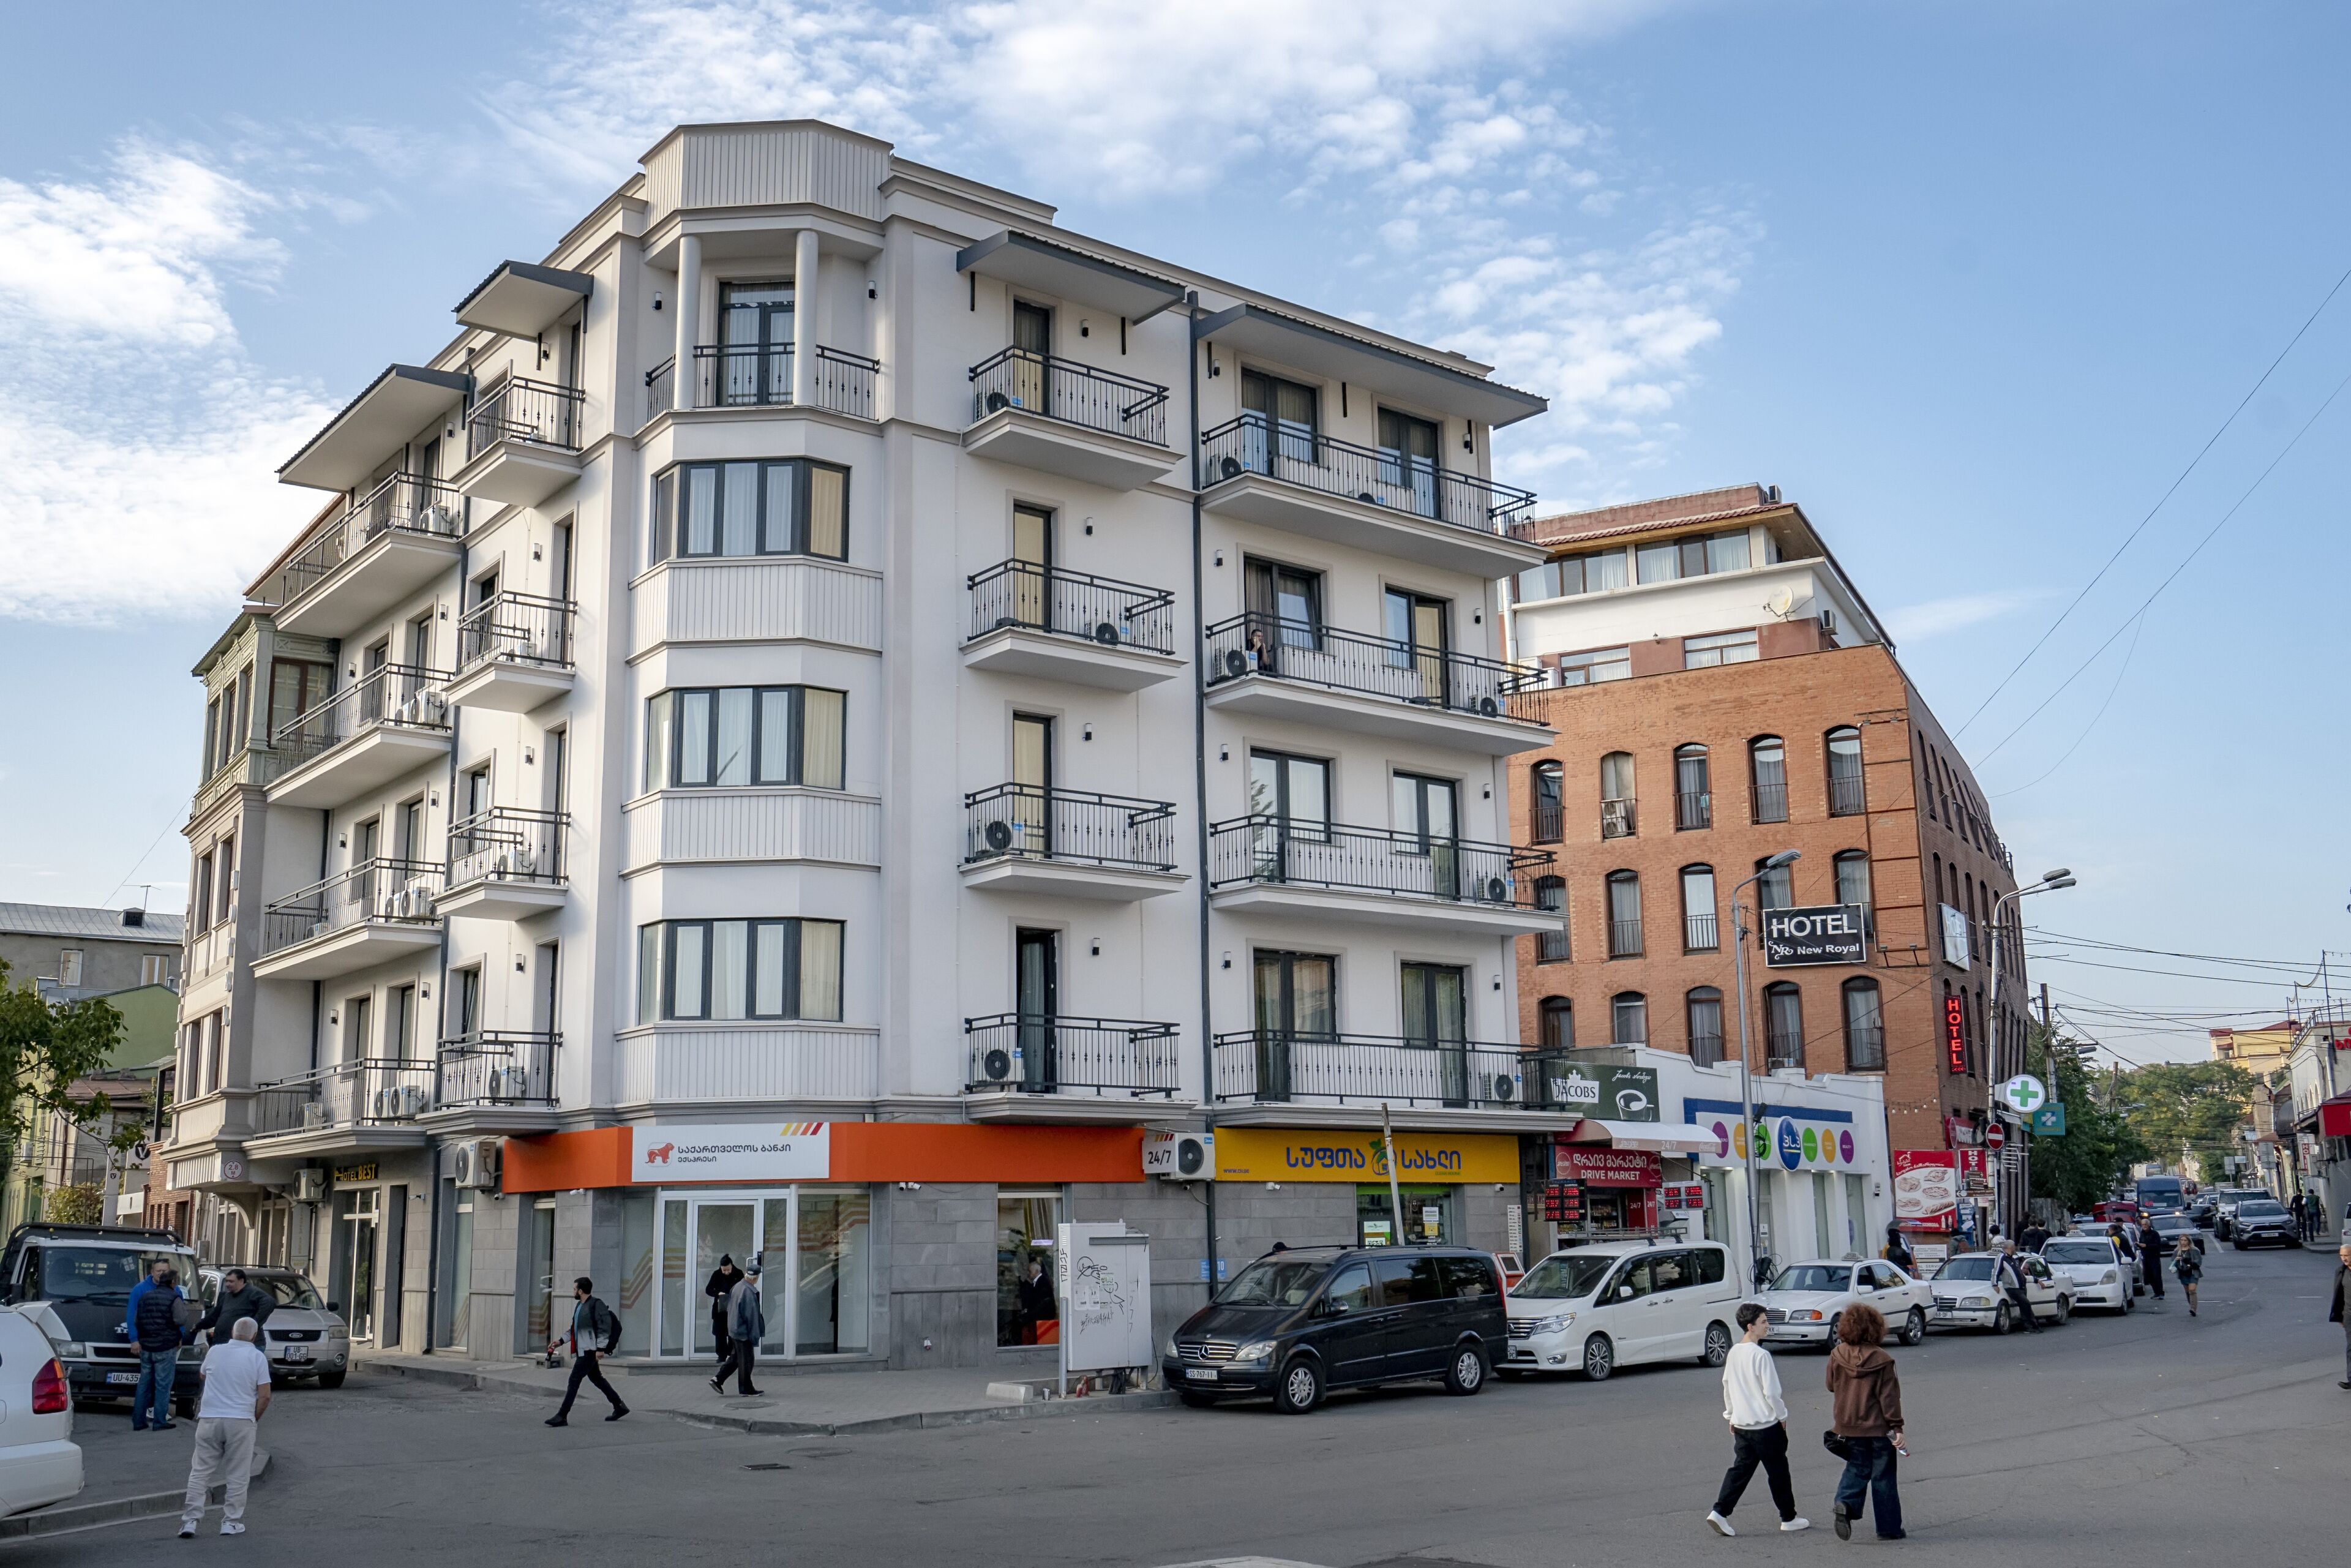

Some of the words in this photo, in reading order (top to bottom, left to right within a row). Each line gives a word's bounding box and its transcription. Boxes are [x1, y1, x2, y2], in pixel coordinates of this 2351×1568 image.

[1771, 914, 1858, 938] HOTEL
[1797, 946, 1823, 955] New
[1826, 943, 1859, 955] Royal
[1948, 999, 1963, 1065] HOTEL
[1612, 1069, 1631, 1082] Jacobs
[1555, 1084, 1596, 1098] JACOBS
[678, 1144, 759, 1154] საქართველოს
[761, 1144, 791, 1152] ბანკი
[1662, 1141, 1677, 1150] 24/7
[1148, 1149, 1171, 1166] 24/7
[1286, 1147, 1366, 1168] სუფთა
[1401, 1149, 1461, 1170] სახლი
[1573, 1153, 1604, 1168] დრაივ
[1607, 1155, 1647, 1168] მარკეტი
[358, 1164, 375, 1180] BEST
[1581, 1170, 1606, 1180] DRIVE
[1608, 1171, 1640, 1180] MARKET
[1217, 1261, 1224, 1271] 10
